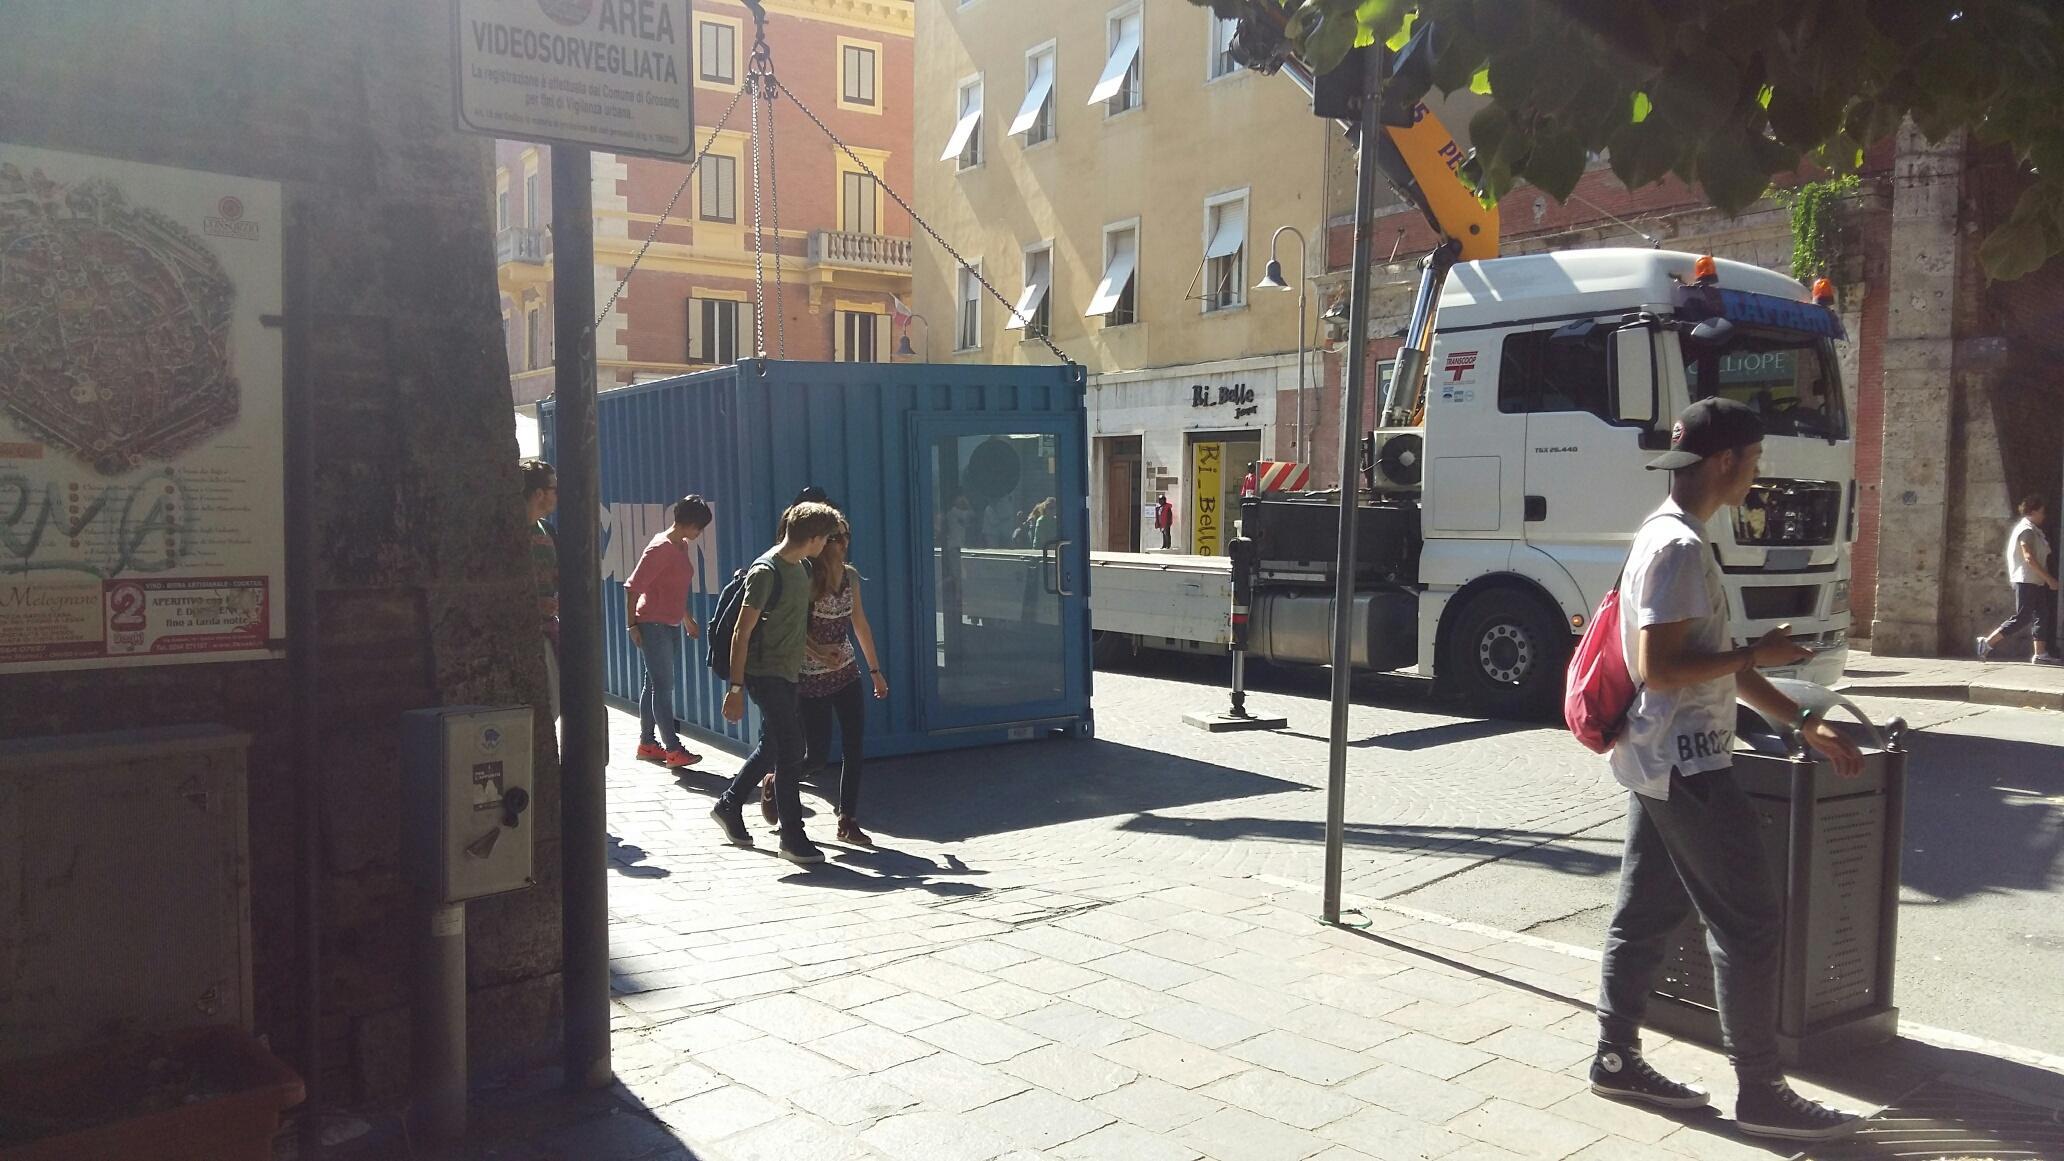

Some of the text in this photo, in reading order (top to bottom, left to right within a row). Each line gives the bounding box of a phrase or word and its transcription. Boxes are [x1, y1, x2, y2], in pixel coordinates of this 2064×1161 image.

[599, 0, 675, 44] AREA
[472, 20, 678, 84] VIDEOSORVEGLIATA
[472, 64, 482, 78] La
[602, 84, 635, 102] Comune
[1446, 356, 1477, 365] TRANSCOOP
[111, 582, 146, 631] 2
[152, 597, 203, 606] APERITIVO
[166, 619, 185, 627] fino
[195, 618, 220, 626] tarda
[223, 617, 248, 625] notte
